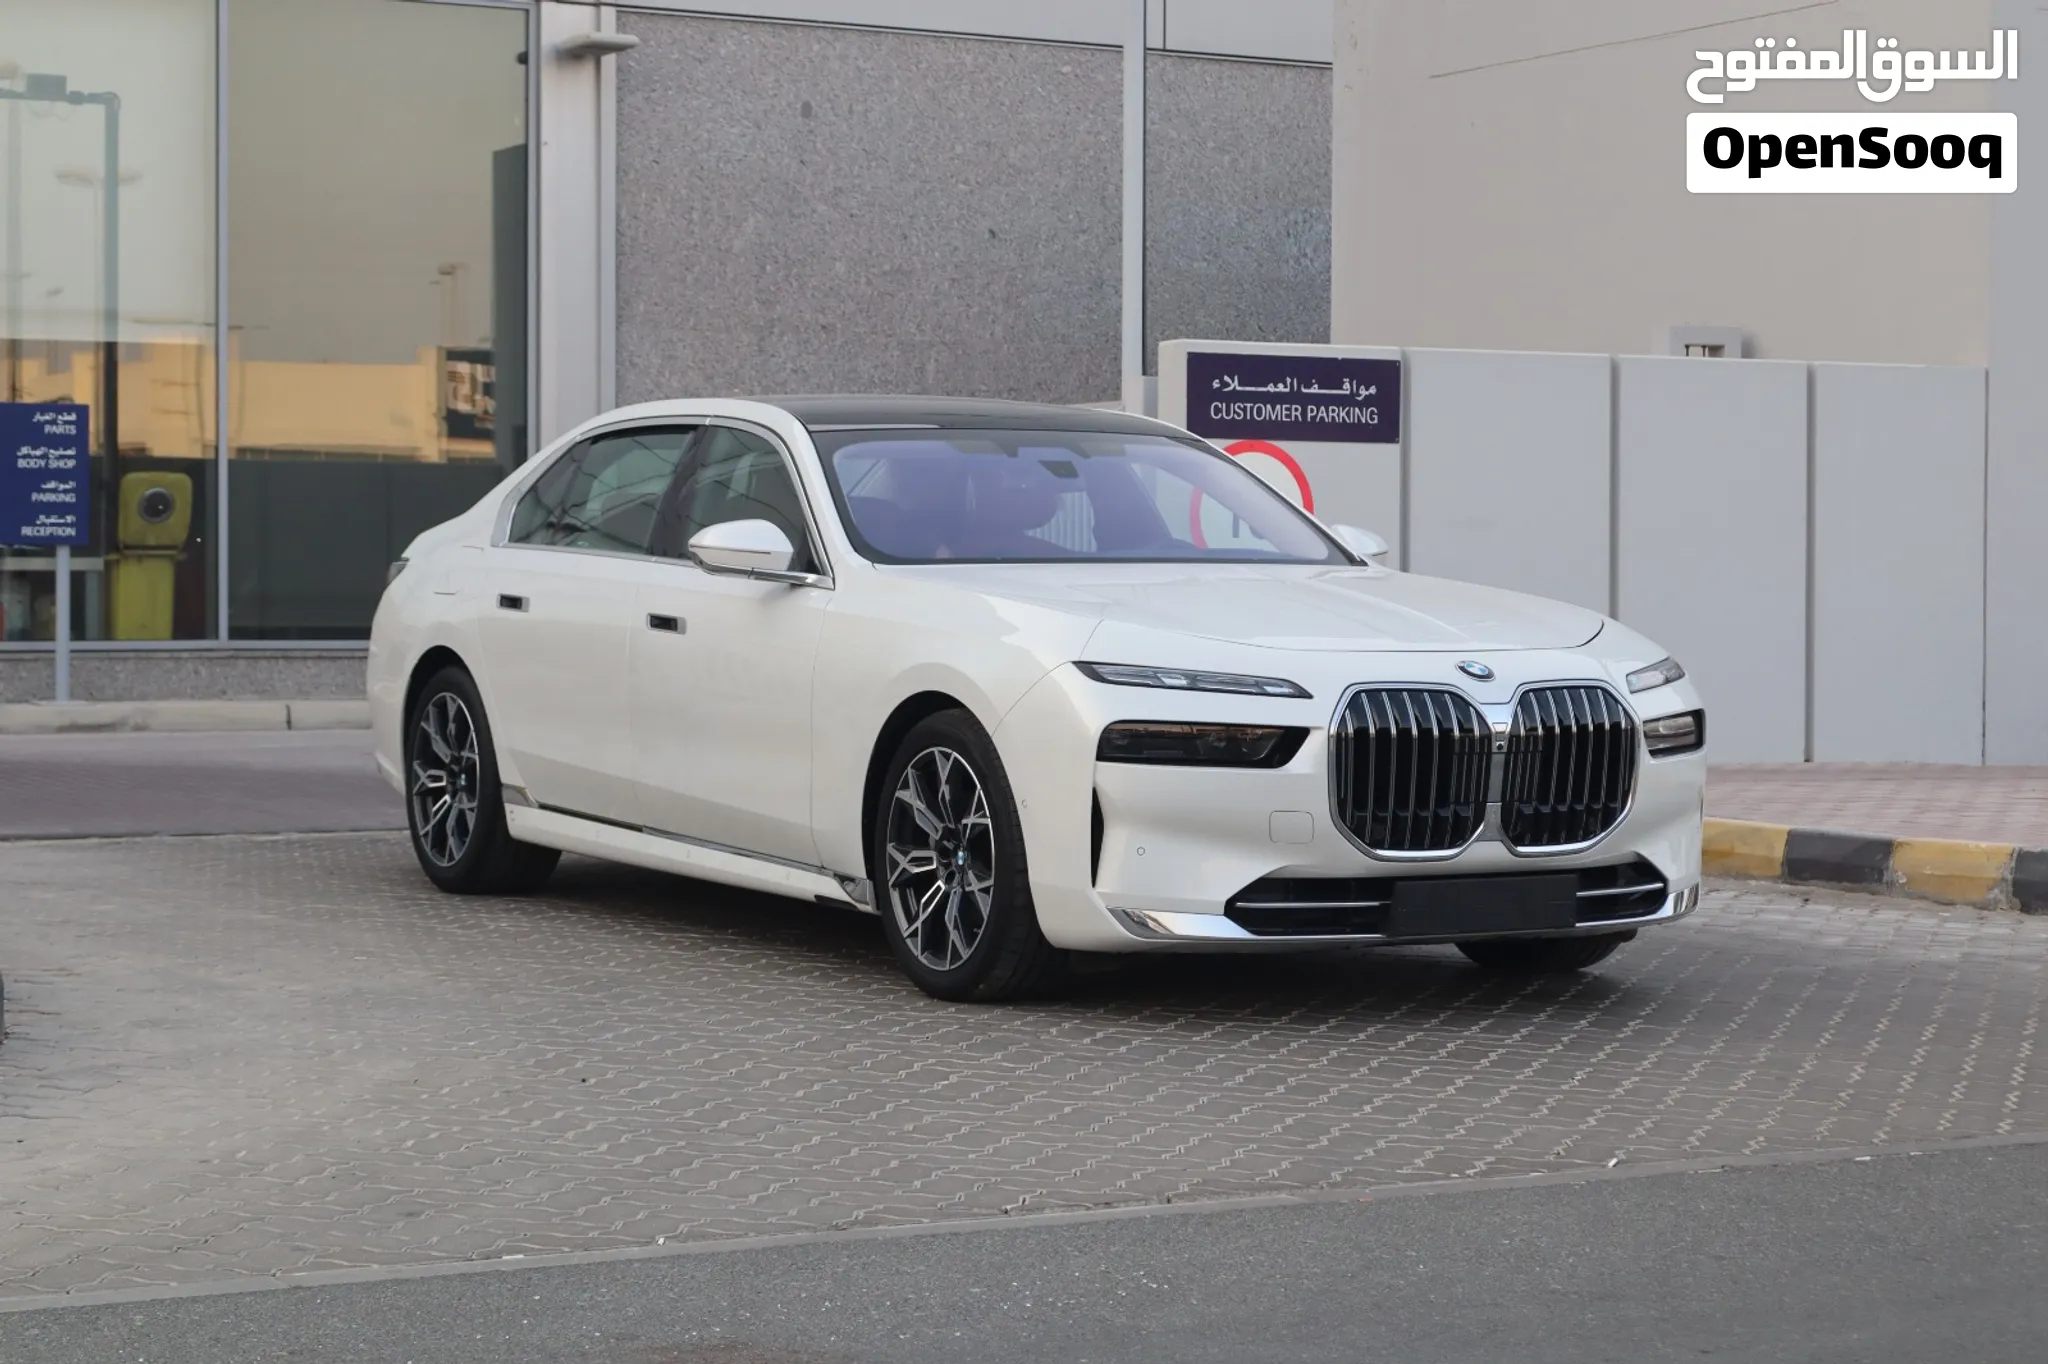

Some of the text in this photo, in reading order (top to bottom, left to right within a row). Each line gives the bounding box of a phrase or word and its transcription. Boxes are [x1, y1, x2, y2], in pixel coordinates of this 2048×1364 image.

[1212, 375, 1377, 400] مواقف العملاء
[1210, 401, 1379, 425] CUSTOMER PARKING
[44, 424, 77, 435] PARTS
[17, 458, 76, 469] BODY SHOP
[31, 492, 76, 503] PARKING
[21, 526, 76, 537] RECEPTION
